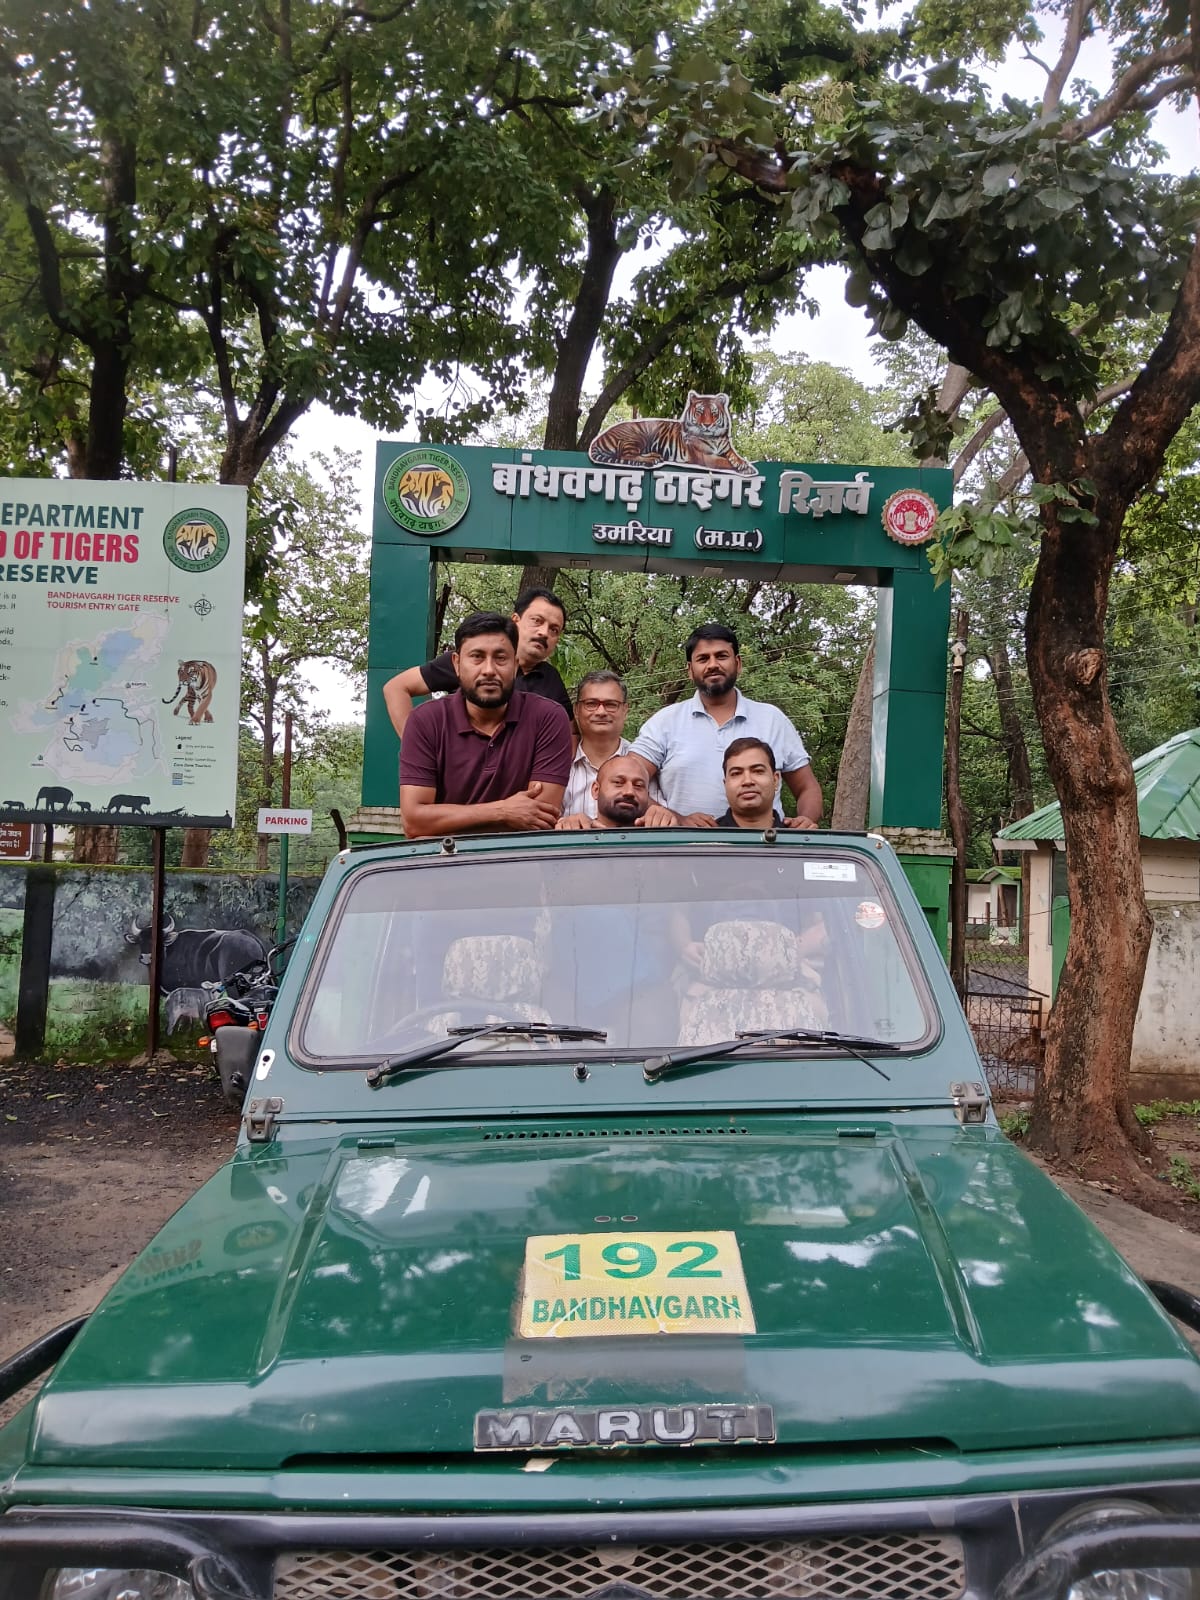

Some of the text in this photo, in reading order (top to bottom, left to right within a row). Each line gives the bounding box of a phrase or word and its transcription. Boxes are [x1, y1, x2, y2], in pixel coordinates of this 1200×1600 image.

[427, 453, 449, 467] TIGER
[492, 453, 645, 512] बांधवगढ़
[1, 502, 145, 530] EPARTMENT
[593, 519, 674, 545] उमरिया
[14, 530, 45, 560] OF
[50, 531, 140, 563] TIGERS
[0, 563, 98, 584] RESERVE
[47, 591, 180, 604] BANDHAVGARH TIGER RESERVE
[47, 601, 140, 612] TOURISM ENTRY GATE
[265, 816, 308, 826] PARKING
[544, 1241, 723, 1280] 192
[532, 1295, 742, 1323] BANDHAVGARH
